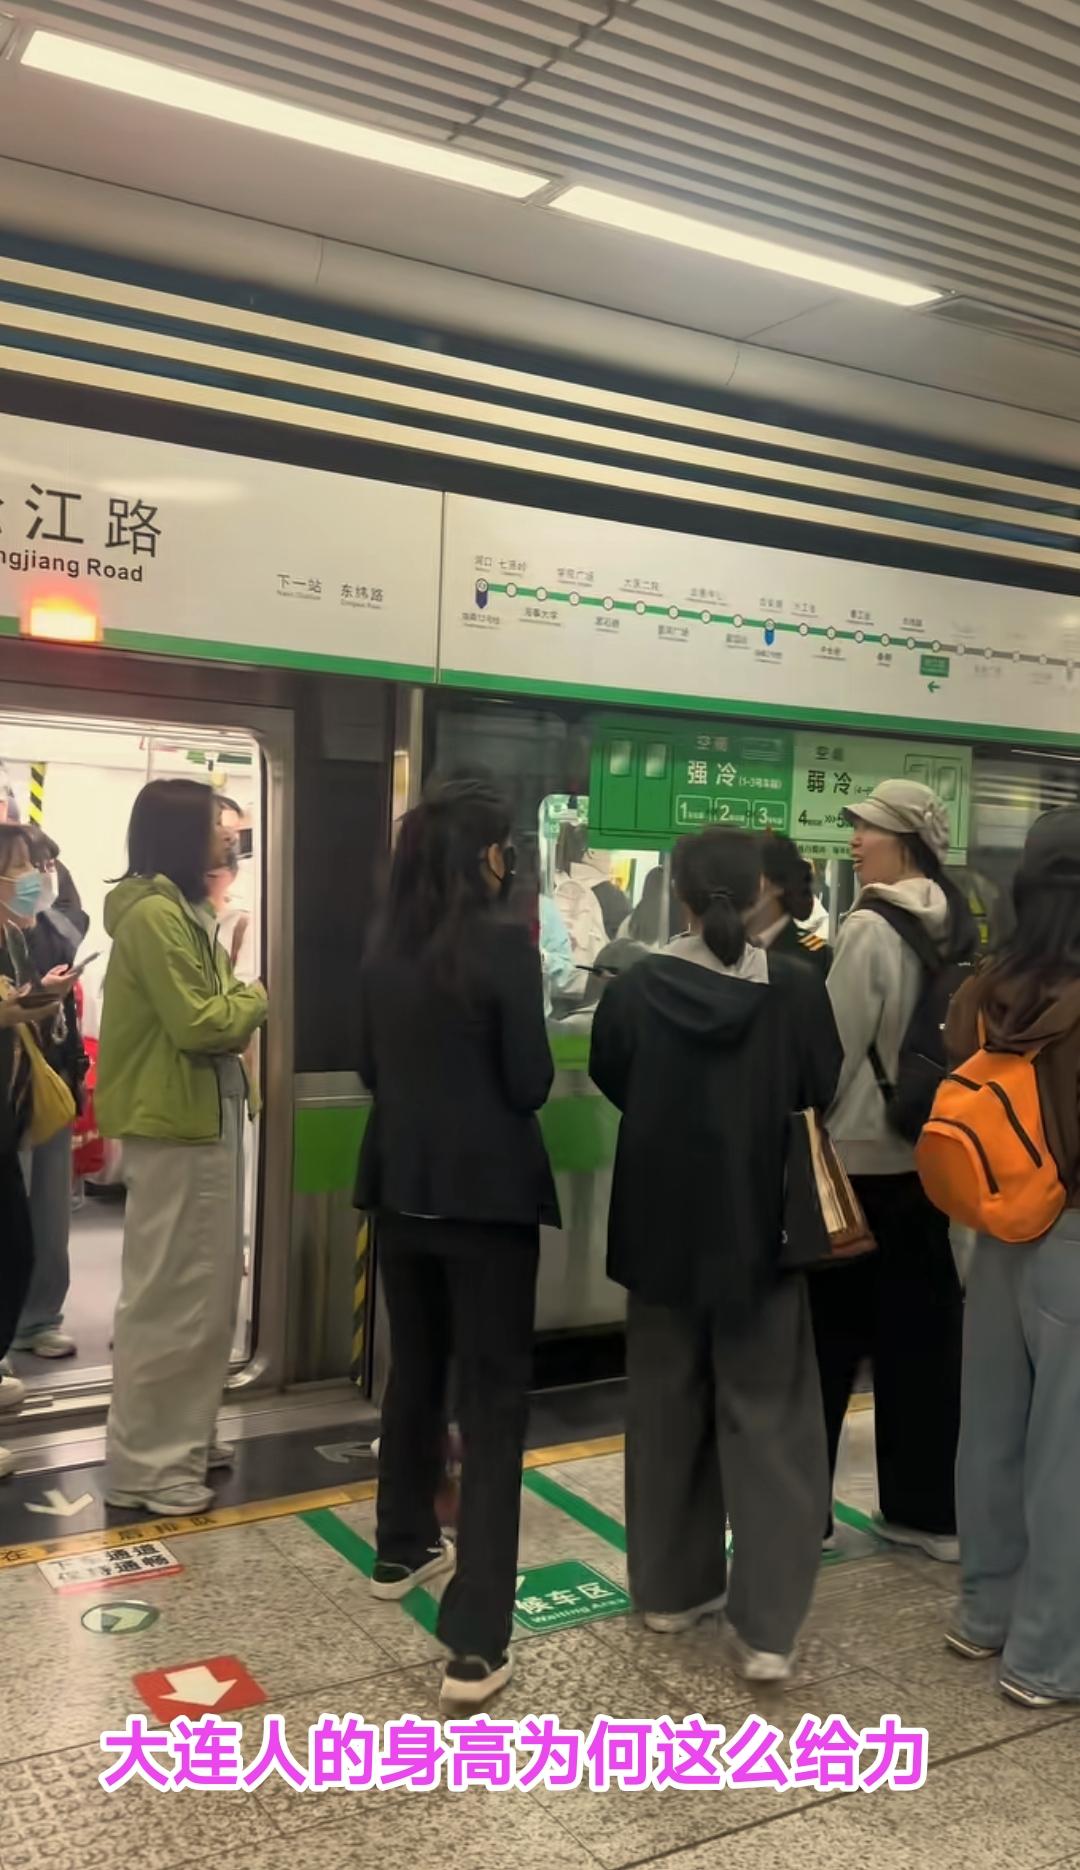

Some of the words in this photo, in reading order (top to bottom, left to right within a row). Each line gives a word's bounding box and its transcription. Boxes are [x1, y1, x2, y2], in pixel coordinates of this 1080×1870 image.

[0, 482, 162, 558] 江路
[87, 557, 143, 583] Road
[276, 574, 322, 593] 下一站
[687, 760, 737, 787] 强冷
[807, 769, 852, 796] 弱冷
[515, 1582, 616, 1615] 候车区
